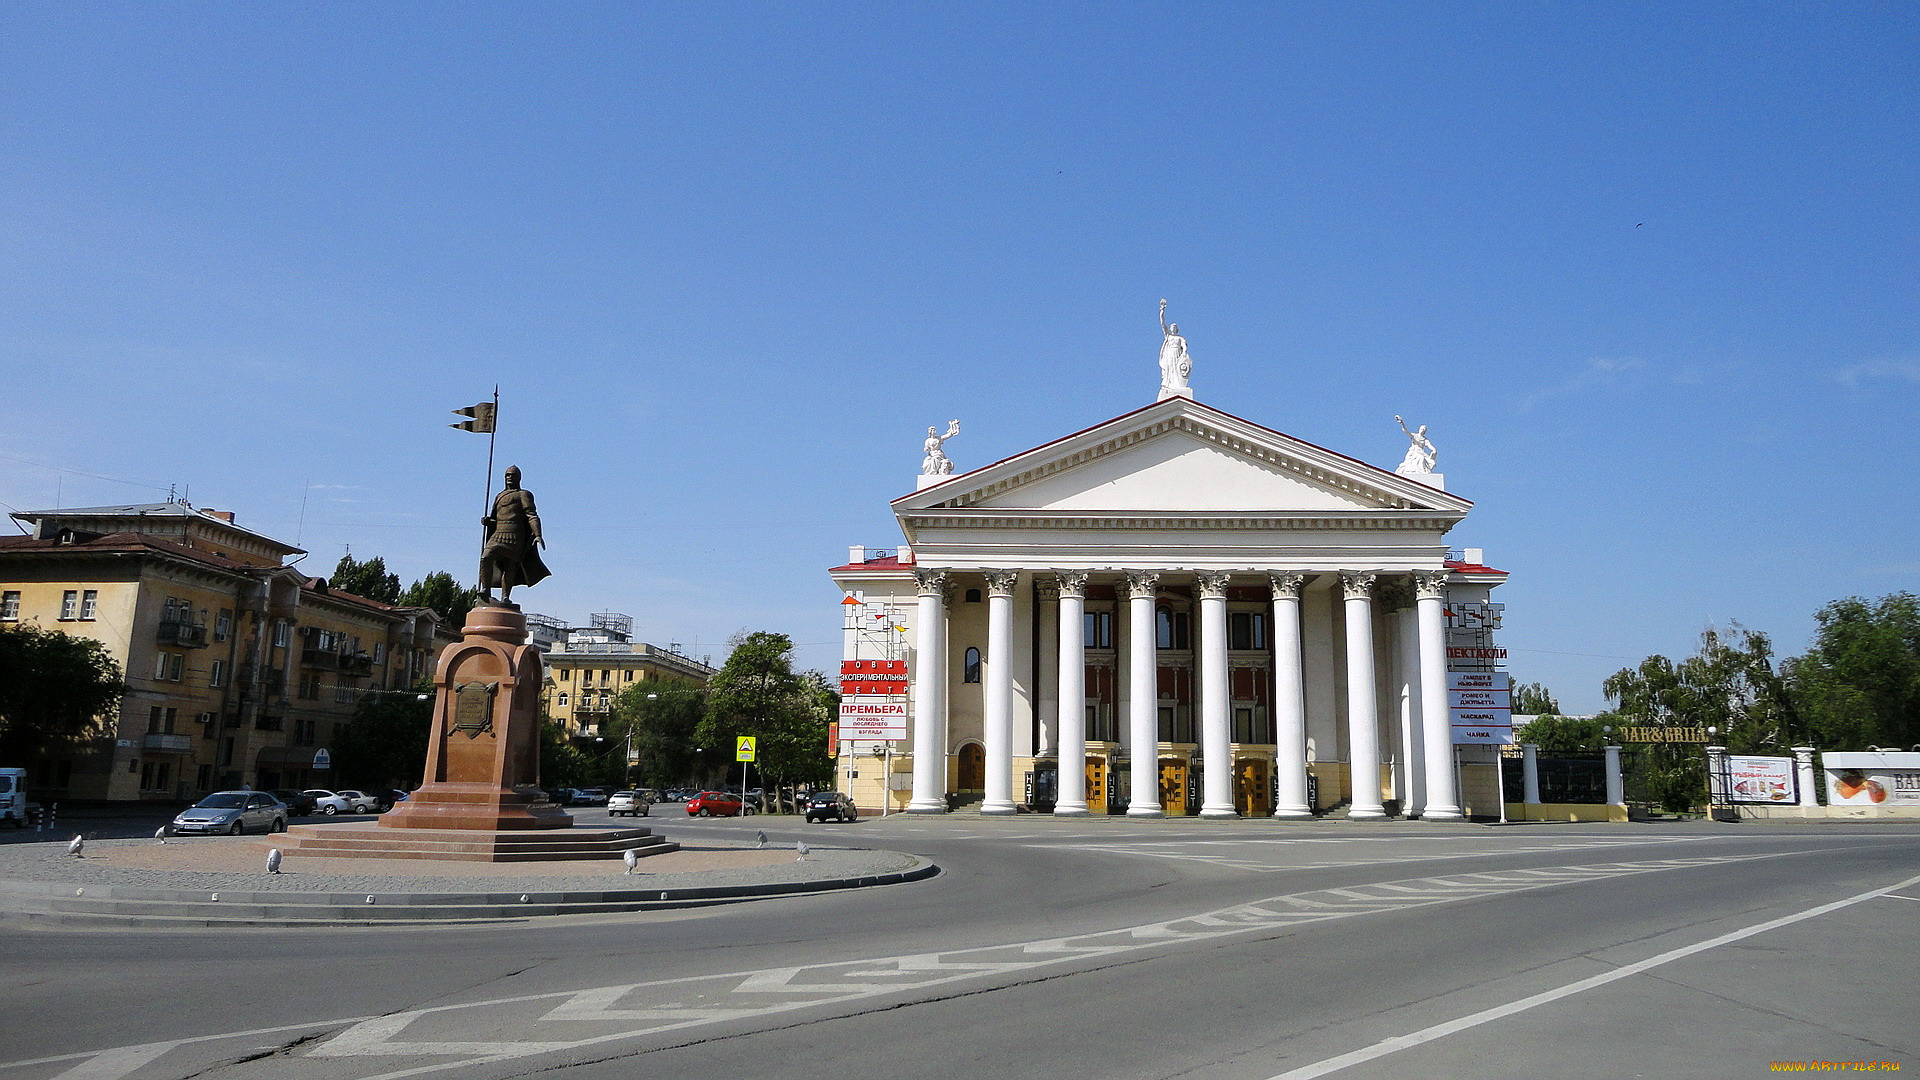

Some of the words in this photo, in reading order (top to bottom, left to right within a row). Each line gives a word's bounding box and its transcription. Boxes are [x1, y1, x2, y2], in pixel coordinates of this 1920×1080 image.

[1446, 647, 1508, 659] ПЕКТАКЛИ
[839, 660, 908, 668] НОВЫЙ
[839, 673, 908, 681] ЭКСПЕРИМЕНТАЛЬНЫЙ
[839, 686, 908, 694] ТЕАТР
[841, 705, 904, 714] ПРЕМЬЕРА
